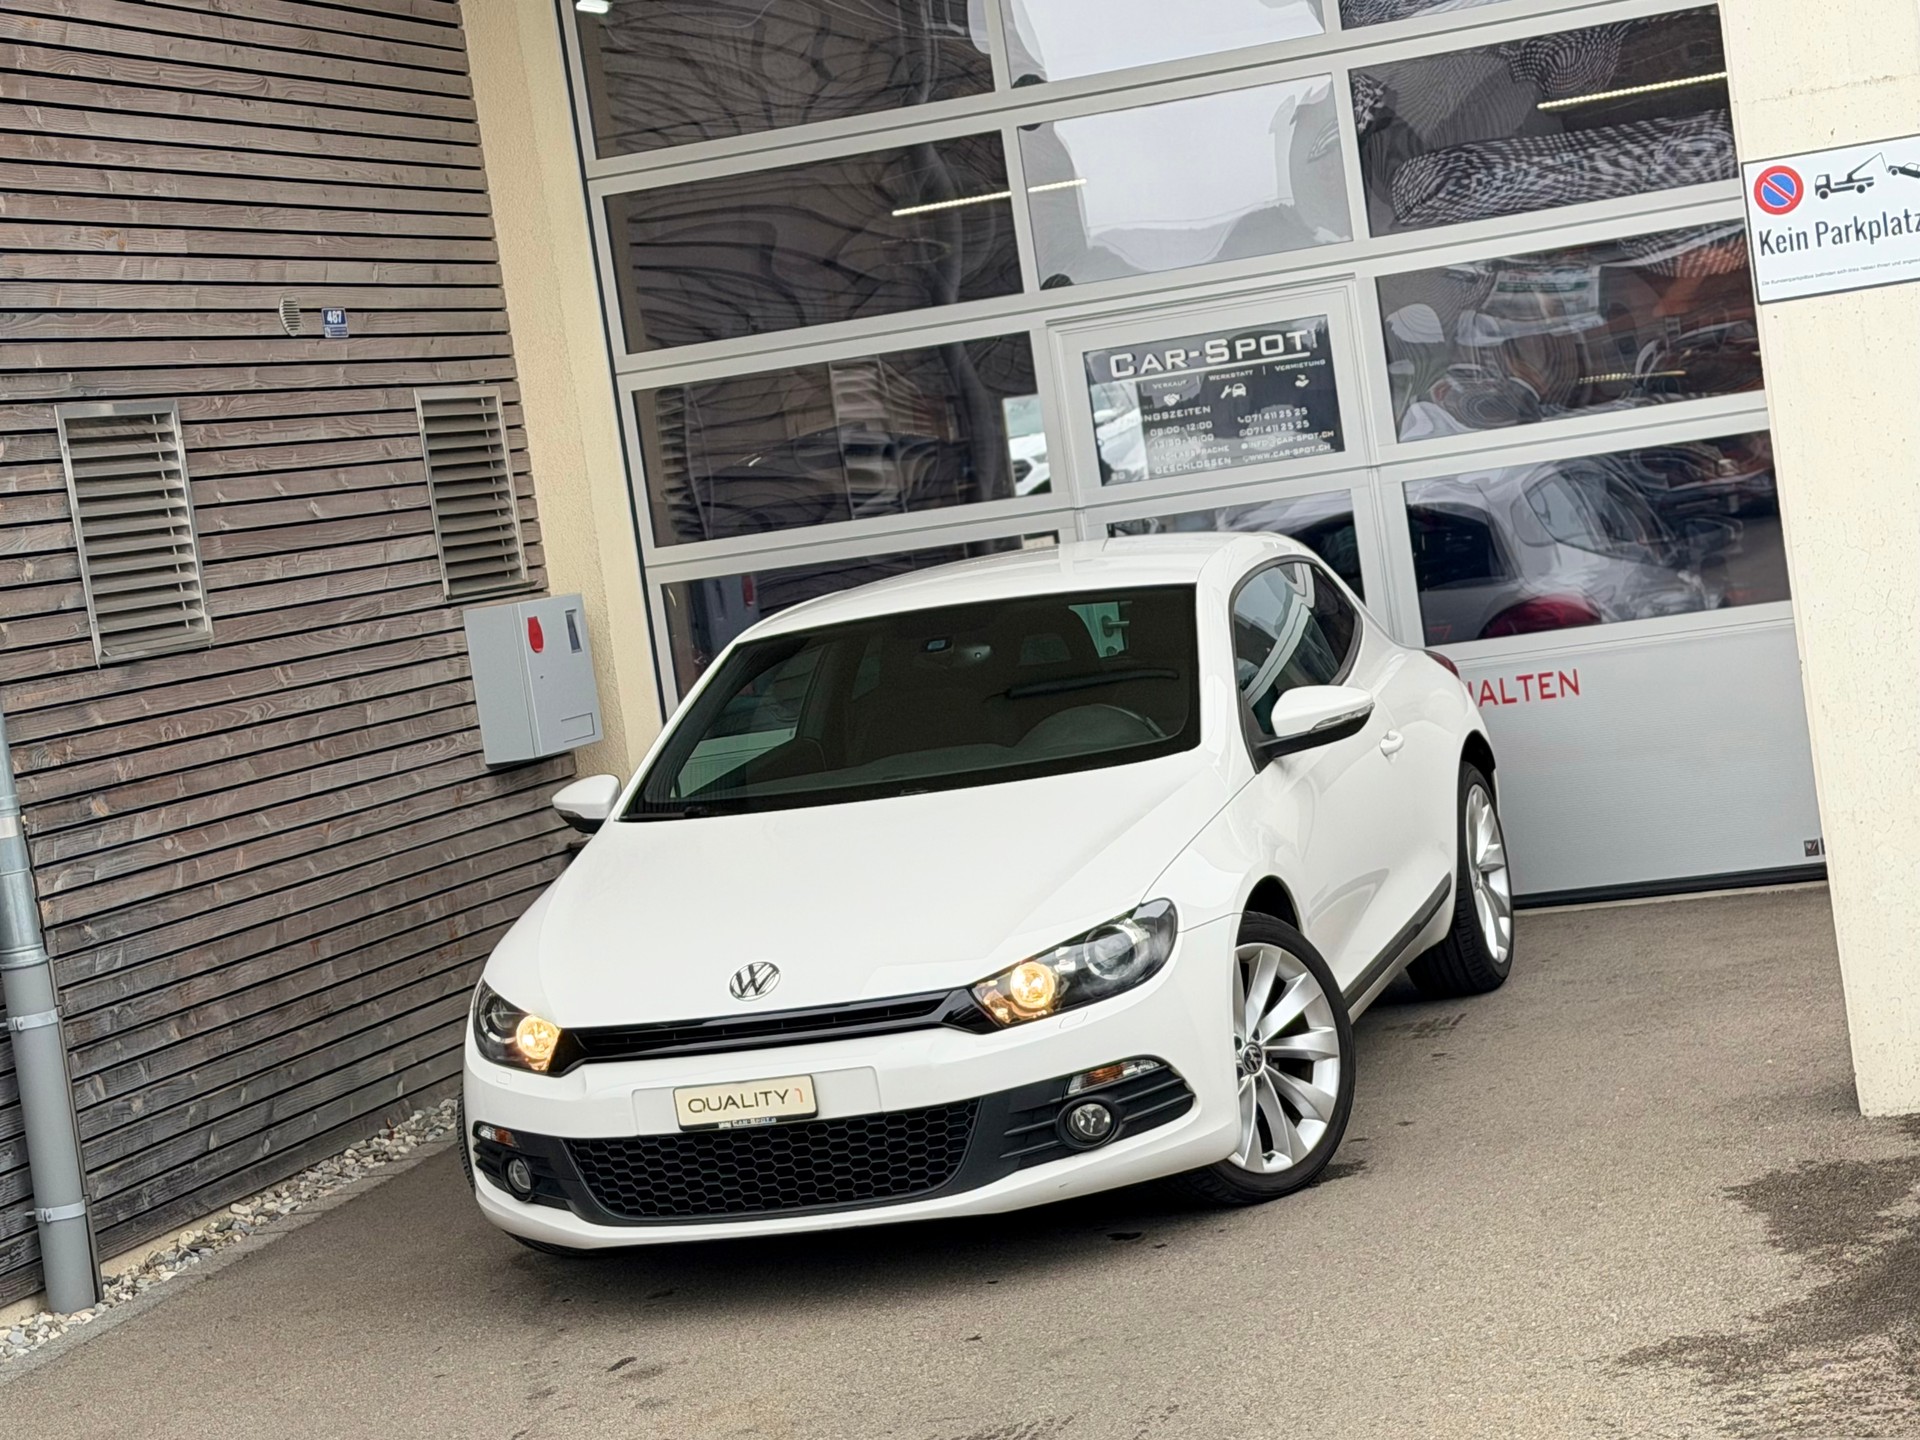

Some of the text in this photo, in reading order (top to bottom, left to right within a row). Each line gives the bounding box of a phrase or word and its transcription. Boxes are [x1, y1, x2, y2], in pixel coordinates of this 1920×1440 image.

[1758, 208, 1920, 257] Kein Parkplatz
[1109, 330, 1308, 378] CAR-SPOT
[1152, 359, 1326, 390] VERKAUF WERKSTATT VERMIETUNG
[687, 1088, 789, 1113] QUALITY
